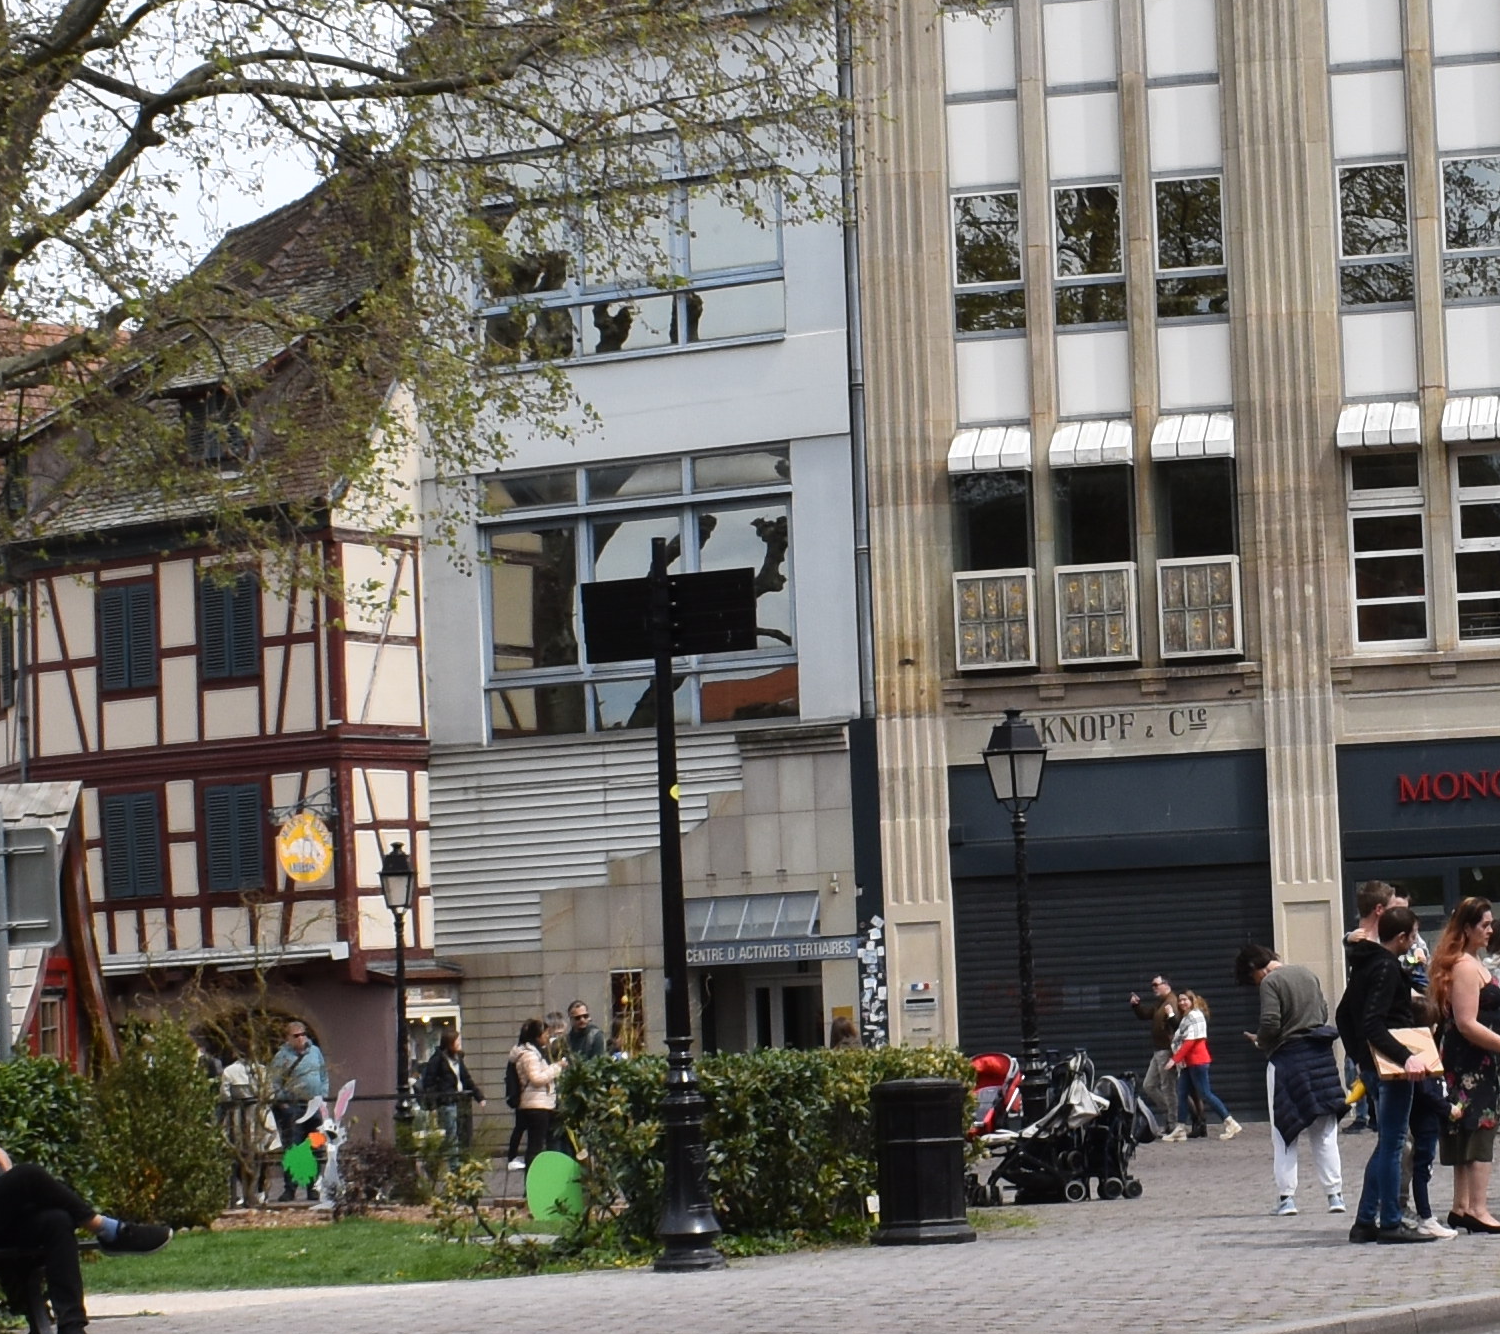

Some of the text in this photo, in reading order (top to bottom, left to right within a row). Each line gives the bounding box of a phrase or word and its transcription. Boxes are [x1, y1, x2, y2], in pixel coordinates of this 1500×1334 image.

[1040, 712, 1135, 744] KNOPF
[1145, 725, 1154, 738] &
[686, 948, 724, 963] CENTRE
[740, 943, 790, 960] ACTIVITES
[794, 940, 851, 957] TERTIAIRES
